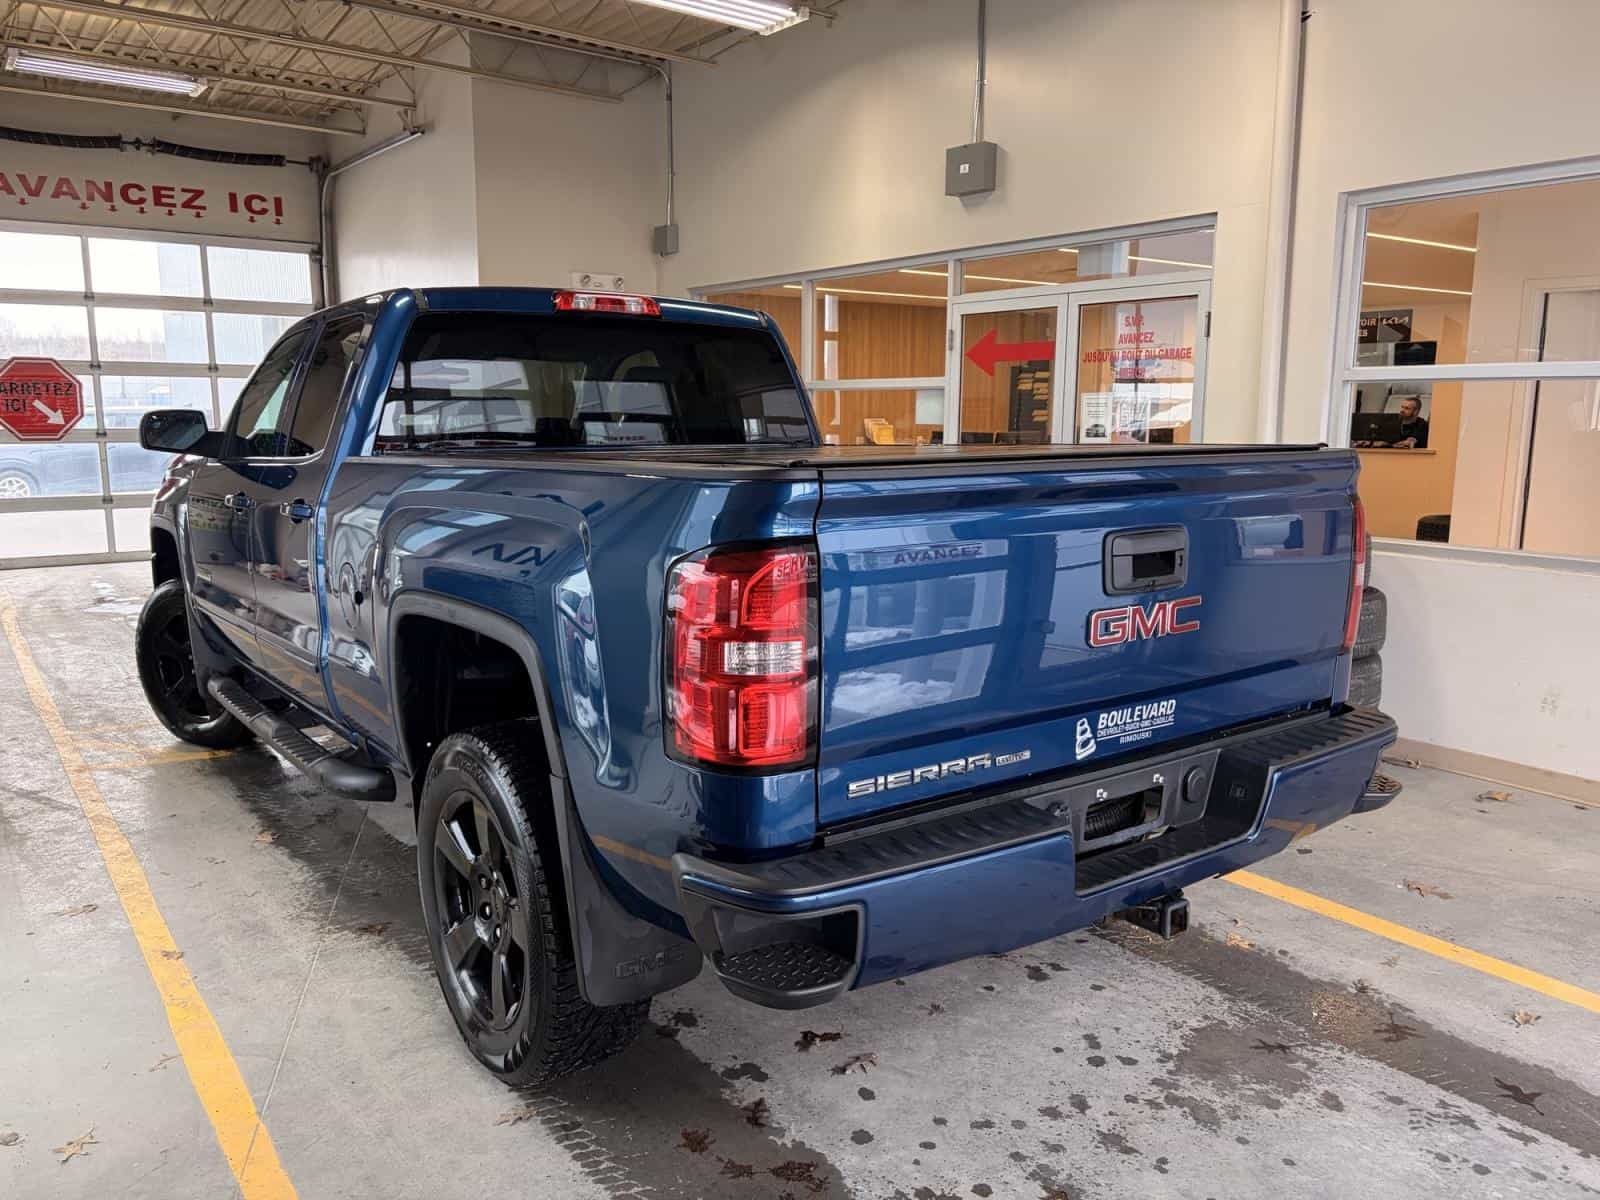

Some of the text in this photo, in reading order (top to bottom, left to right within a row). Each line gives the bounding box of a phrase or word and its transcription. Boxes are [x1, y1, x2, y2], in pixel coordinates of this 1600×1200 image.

[0, 171, 207, 211] AVANCEZ
[1118, 331, 1155, 345] AVANCEZ
[1082, 350, 1120, 364] JUSQU'AU
[1157, 346, 1193, 360] GARAGE
[5, 398, 27, 412] ICI
[1087, 596, 1203, 648] GMC
[1097, 699, 1177, 730] BOULEVARD
[1119, 730, 1153, 745] RIMOUSKI
[847, 752, 992, 799] SIERRA
